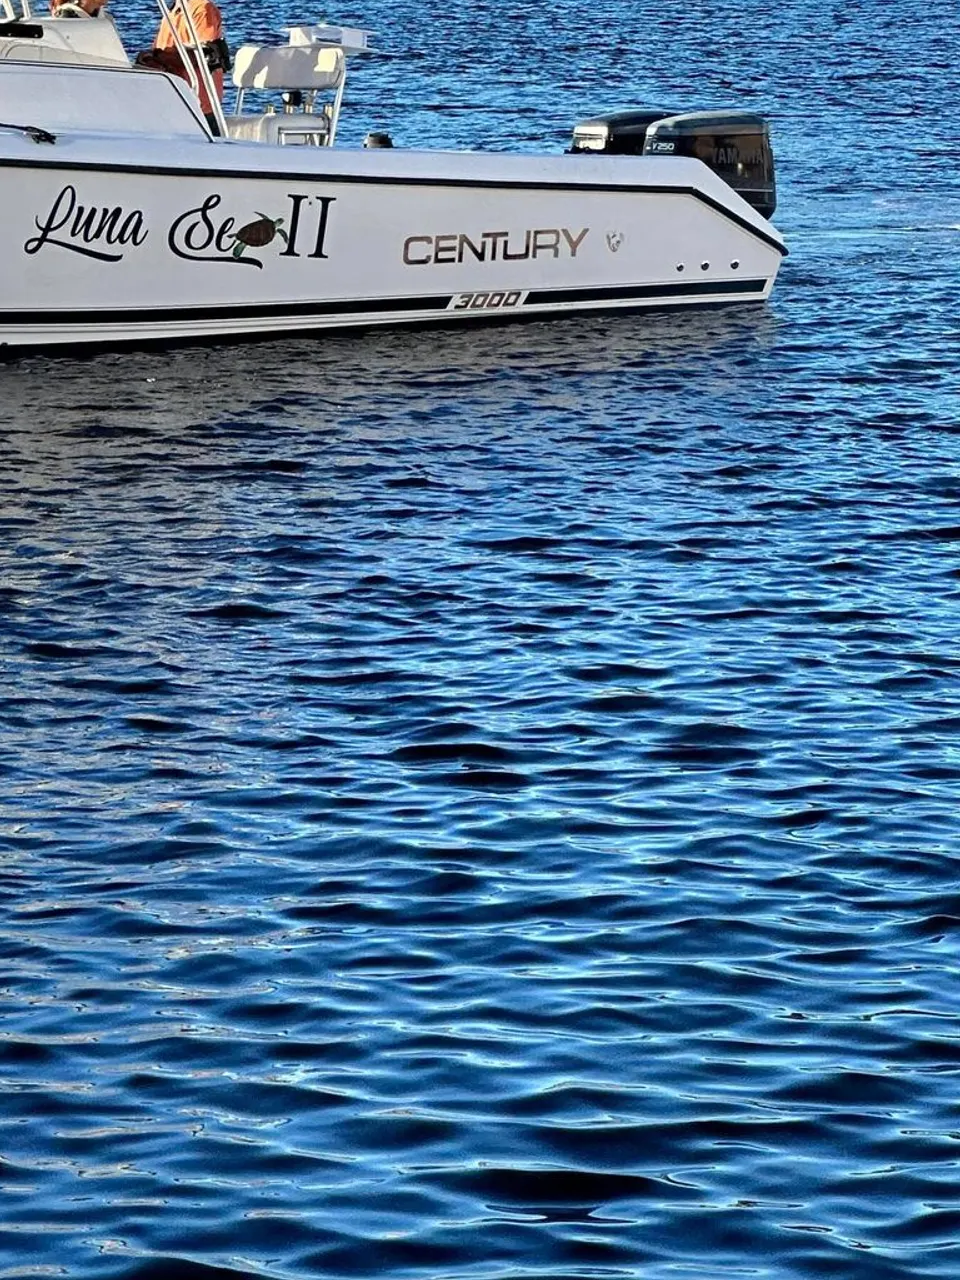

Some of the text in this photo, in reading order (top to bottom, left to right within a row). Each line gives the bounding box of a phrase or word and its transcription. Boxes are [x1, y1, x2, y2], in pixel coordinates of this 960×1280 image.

[24, 184, 149, 262] Luna
[279, 194, 337, 259] II
[402, 228, 590, 266] CENTURY
[454, 291, 522, 309] 3000
